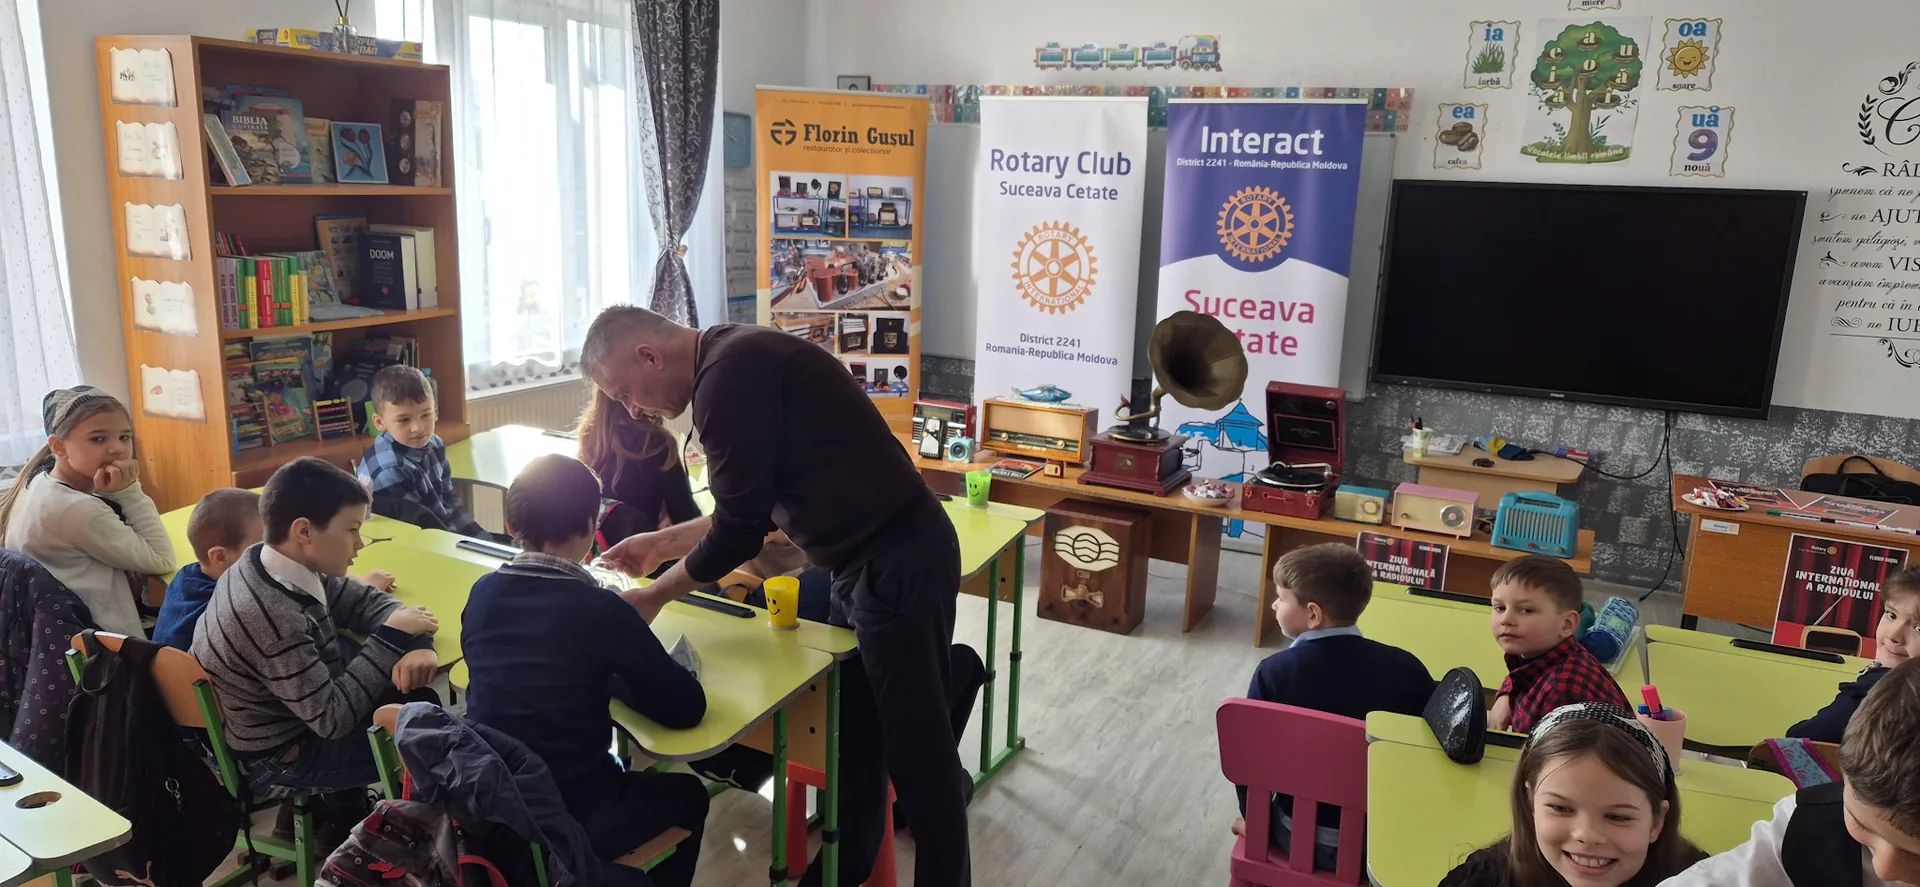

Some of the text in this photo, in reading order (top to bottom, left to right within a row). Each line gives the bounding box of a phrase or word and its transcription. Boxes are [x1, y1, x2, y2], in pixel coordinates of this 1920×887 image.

[1484, 23, 1504, 41] ia
[1678, 22, 1707, 37] oa
[1583, 31, 1596, 44] a
[1550, 47, 1562, 58] e
[1620, 44, 1633, 56] u
[1583, 59, 1596, 71] o
[1478, 77, 1500, 85] iarbă
[1549, 66, 1557, 82] i
[1452, 106, 1475, 119] ea
[1692, 106, 1719, 127] uă
[231, 115, 269, 125] BIBLIA
[803, 123, 915, 147] Florin Gușul
[1201, 126, 1325, 155] Interact
[803, 144, 843, 153] restaurator
[851, 147, 891, 155] colecționar
[1527, 144, 1562, 160] Vocalele
[1590, 147, 1624, 159] române
[1687, 129, 1718, 161] 9
[990, 148, 1131, 179] Rotary Club
[1177, 157, 1204, 167] District
[1206, 159, 1226, 167] 2241
[1233, 159, 1311, 169] România-Republica
[1312, 160, 1348, 170] Moldova
[1684, 164, 1711, 172] nouă
[1000, 181, 1118, 200] Suceava Cetate
[1827, 186, 1914, 202] spunem că ne
[1240, 194, 1272, 204] ROTARY
[1851, 213, 1866, 221] ne
[1037, 231, 1074, 242] ROTARY
[1811, 230, 1853, 244] suntem
[1228, 235, 1281, 254] INTERNATIONAL
[370, 249, 394, 259] DOOM
[1850, 261, 1884, 269] avem
[1818, 277, 1875, 289] avansăm
[1024, 280, 1084, 305] INTERNATIONAL
[1185, 289, 1315, 324] Suceava
[1834, 298, 1877, 312] pentru
[1881, 299, 1896, 310] că
[1899, 299, 1913, 311] în
[1867, 321, 1882, 329] ne
[1020, 333, 1081, 348] District 2241
[985, 342, 1118, 366] Romania-Republica Moldova
[1389, 555, 1409, 565] ZIUA
[1380, 570, 1425, 585] RADIOULUI
[1830, 565, 1854, 577] ZIUA
[1806, 582, 1874, 600] A RADIOULUI
